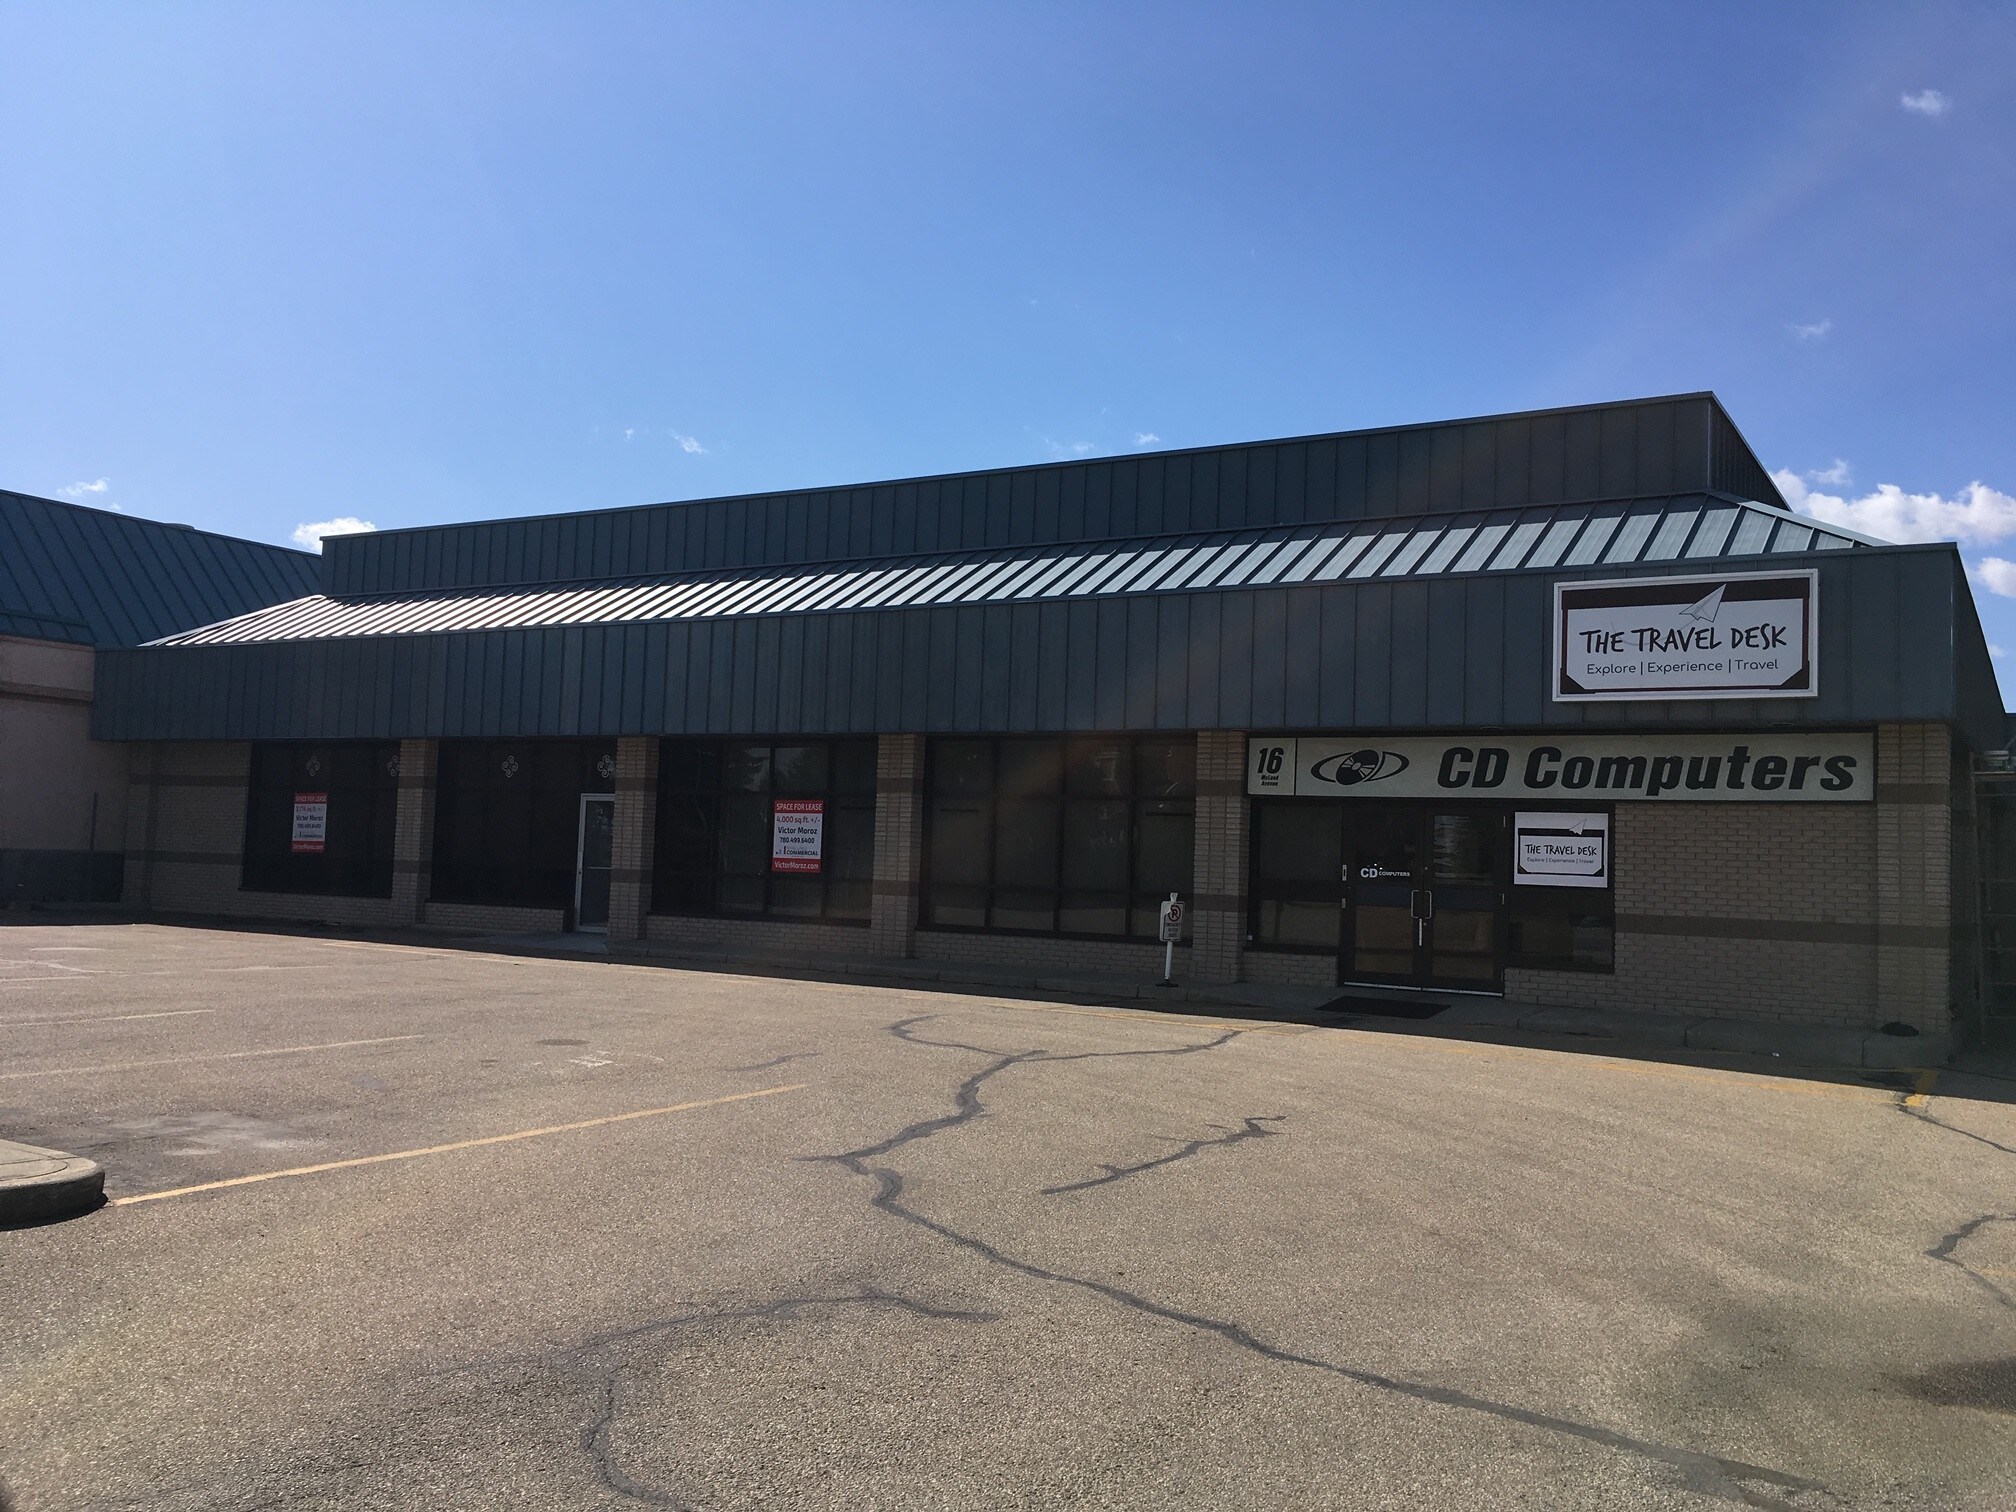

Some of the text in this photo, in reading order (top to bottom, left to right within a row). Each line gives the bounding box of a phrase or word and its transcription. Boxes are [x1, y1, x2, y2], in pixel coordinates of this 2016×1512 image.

[1579, 622, 1787, 654] THE TRAVEL DESK
[1587, 659, 1779, 676] Explore Experience Travel
[1257, 747, 1284, 774] 16
[1437, 745, 1857, 797] CD Computers
[776, 803, 823, 811] SPACE FOR LEASE
[798, 827, 817, 835] Moroz
[1525, 844, 1597, 856] THE TRAVEL DESK
[774, 861, 819, 869] VictorMoroz.com
[1360, 868, 1378, 878] CD
